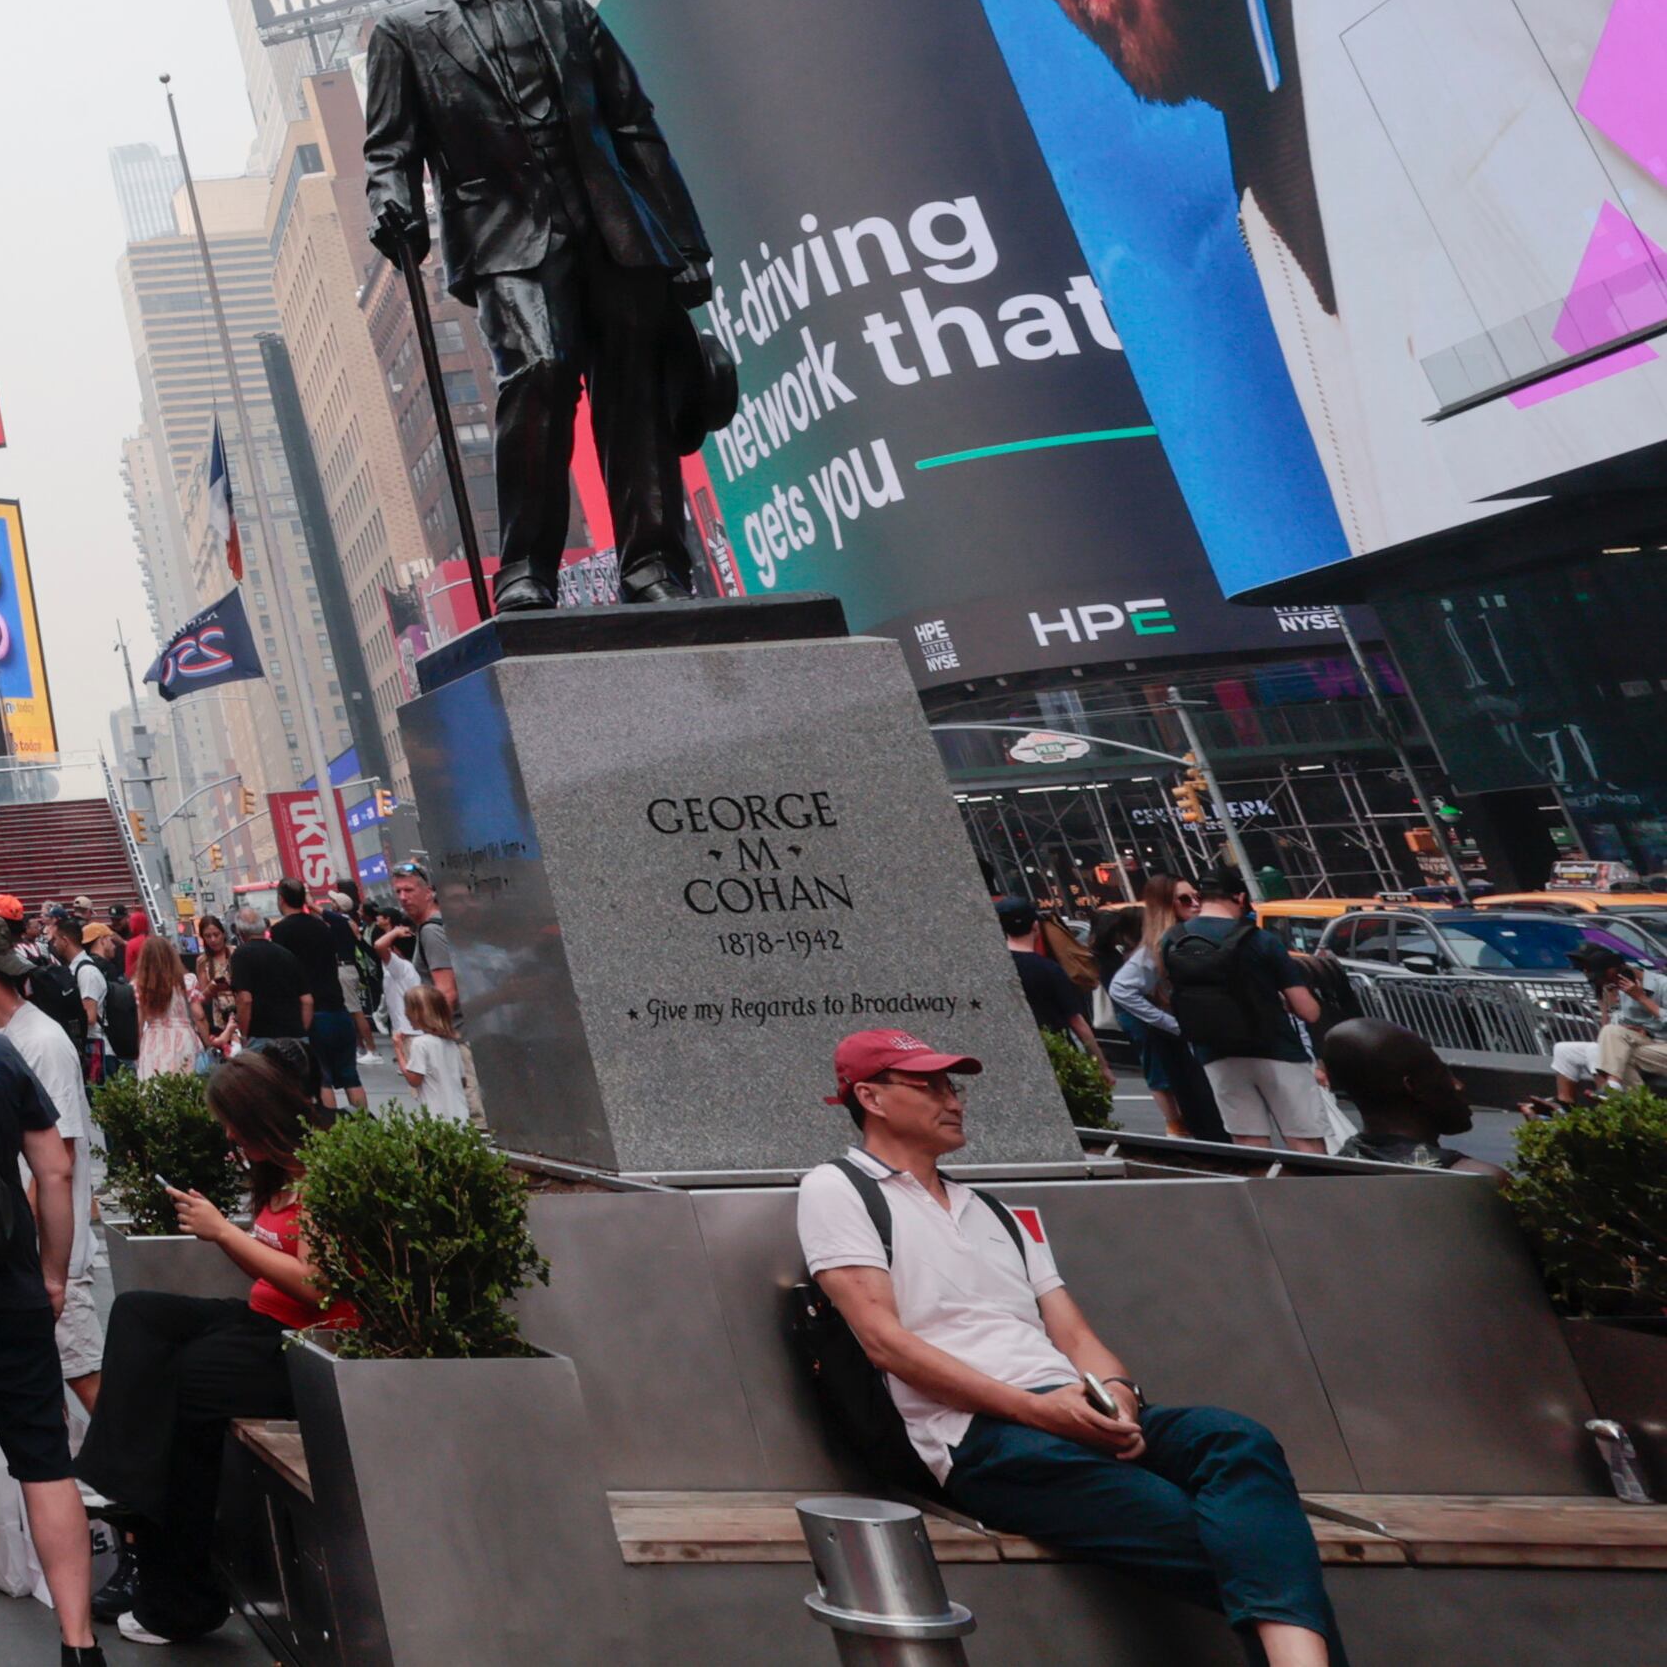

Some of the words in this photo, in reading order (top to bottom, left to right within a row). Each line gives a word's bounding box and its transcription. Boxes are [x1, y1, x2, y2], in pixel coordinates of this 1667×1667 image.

[713, 326, 857, 483] network
[862, 273, 1128, 388] that
[741, 482, 817, 591] gets
[809, 437, 905, 551] you
[914, 620, 947, 646] HPE
[1028, 598, 1177, 647] HPE
[1278, 613, 1341, 633] NYSE
[926, 652, 960, 673] NYSE
[646, 791, 838, 835] GEORGE
[738, 836, 782, 872] M
[683, 874, 855, 915] COHAN
[717, 929, 844, 959] 1878-1942
[646, 998, 688, 1029] Give
[694, 1002, 724, 1026] my
[731, 996, 817, 1025] Regards
[822, 995, 844, 1015] to
[850, 992, 958, 1020] Broadway
